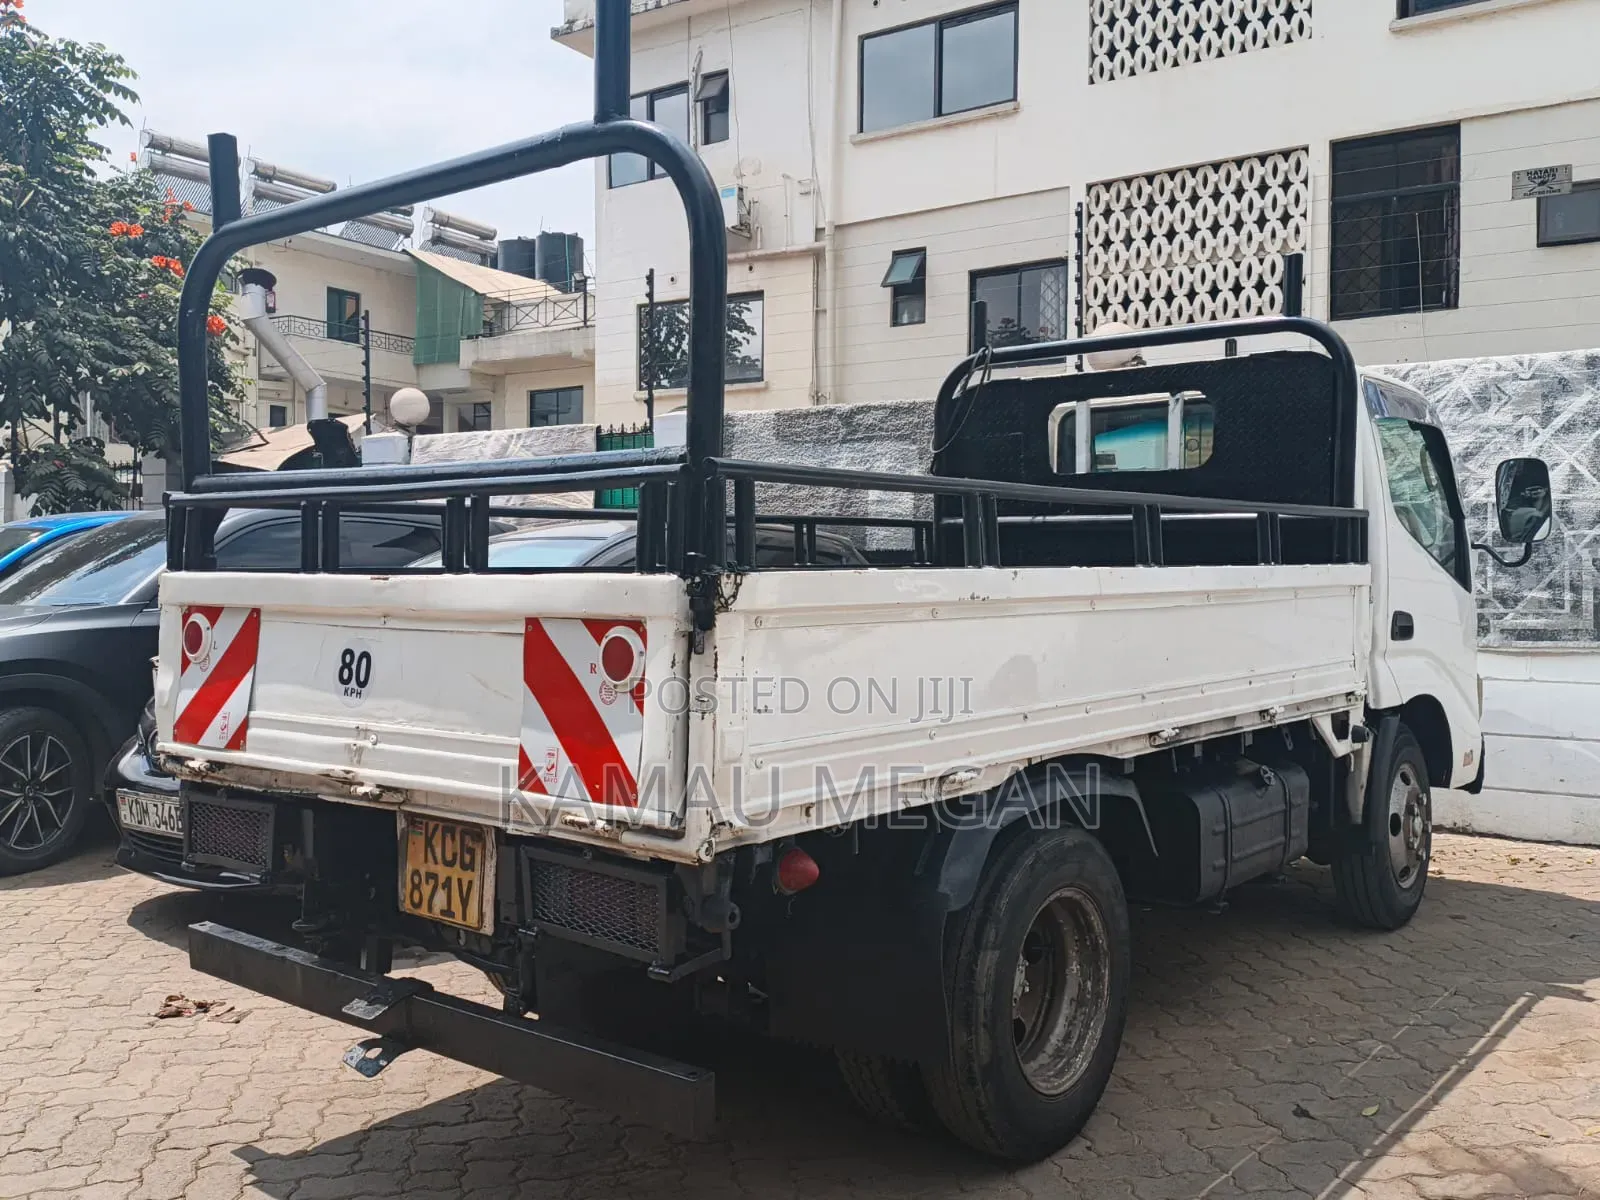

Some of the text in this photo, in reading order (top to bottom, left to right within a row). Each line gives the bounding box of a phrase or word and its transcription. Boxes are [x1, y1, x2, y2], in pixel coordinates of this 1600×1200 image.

[338, 648, 372, 689] 80
[589, 662, 598, 674] R
[343, 687, 362, 699] KPH
[424, 821, 476, 872] KCG
[409, 868, 473, 921] 871Y
